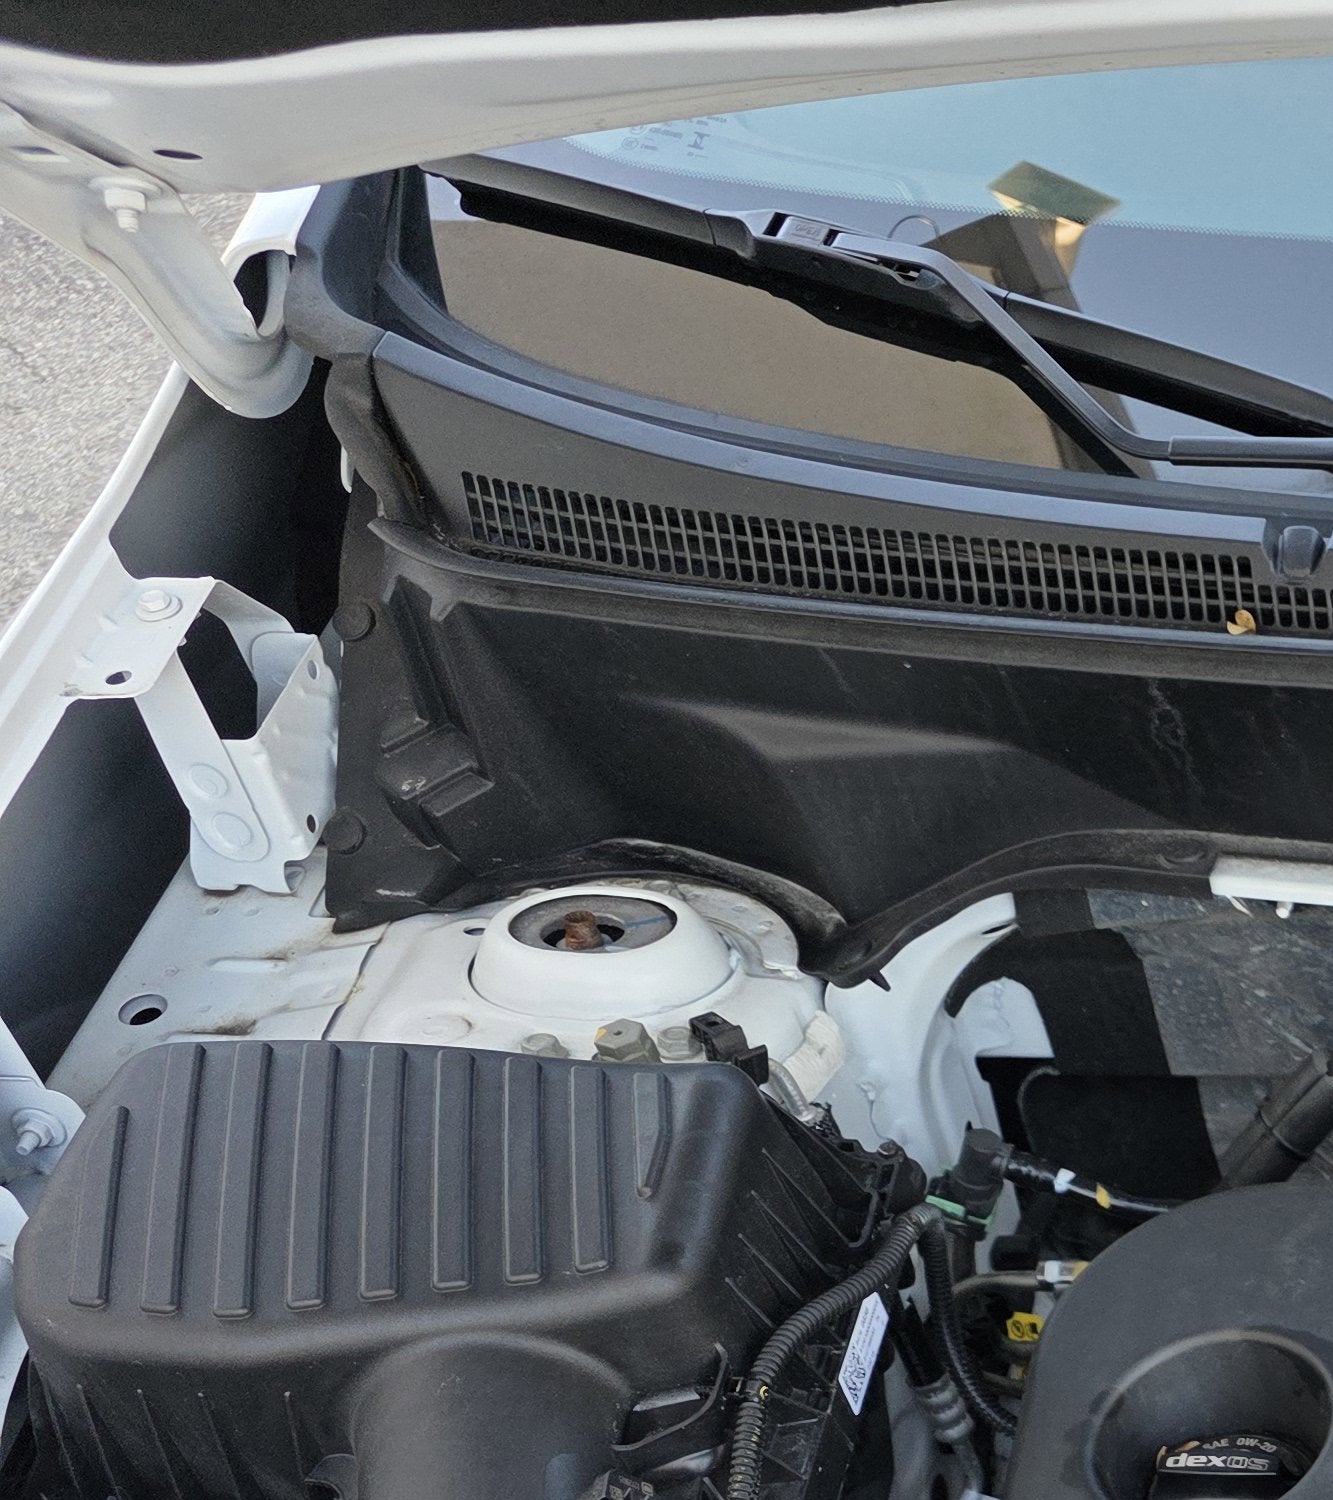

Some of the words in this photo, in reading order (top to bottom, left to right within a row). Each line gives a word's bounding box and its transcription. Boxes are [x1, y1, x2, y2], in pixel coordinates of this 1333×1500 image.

[1201, 1438, 1230, 1450] SAE
[1235, 1437, 1278, 1453] 0W-20
[1165, 1452, 1270, 1471] dexos
